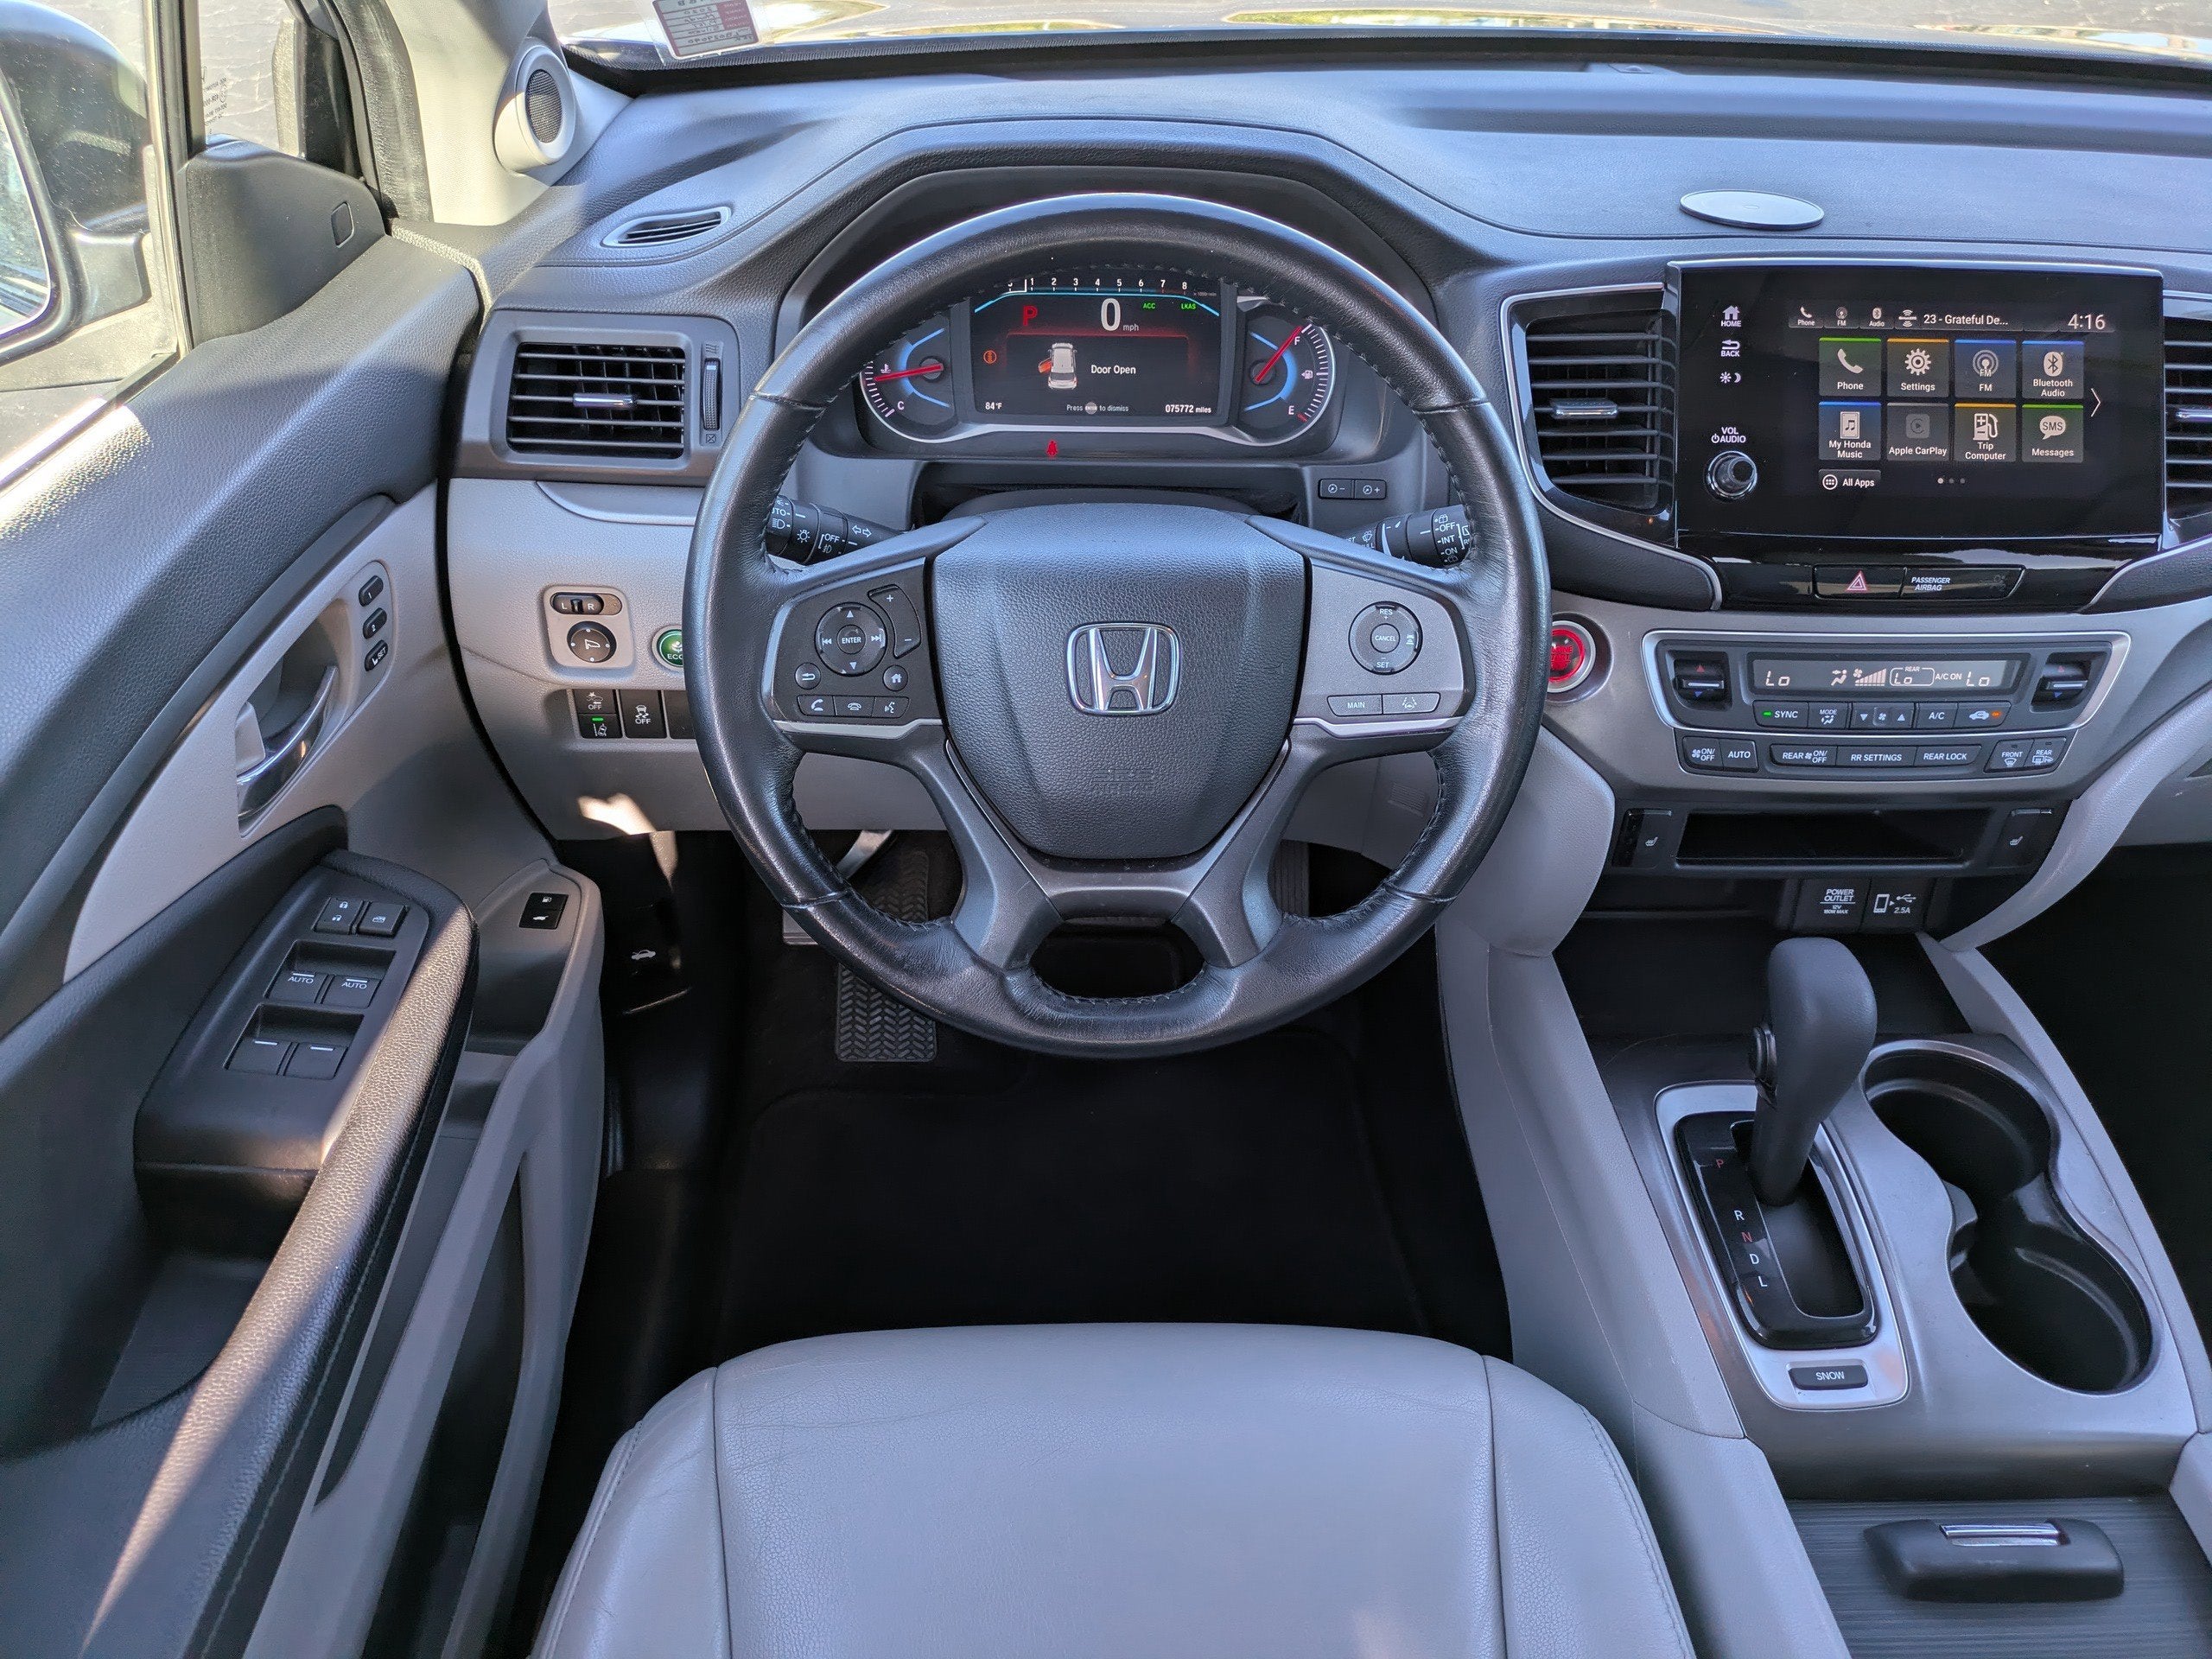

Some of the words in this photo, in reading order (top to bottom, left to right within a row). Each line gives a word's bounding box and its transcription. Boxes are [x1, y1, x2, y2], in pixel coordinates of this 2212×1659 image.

[1052, 277, 1057, 286] 2
[1073, 277, 1078, 286] 3
[1095, 277, 1101, 286] 4
[1116, 278, 1122, 287] 5
[1160, 279, 1166, 288] 7
[1022, 305, 1038, 326] P
[1100, 297, 1121, 331] 0
[1122, 323, 1140, 332] mph
[1923, 314, 1936, 324] 23
[1944, 314, 1985, 325] Grateful
[2067, 314, 2106, 330] 4:16
[1294, 336, 1300, 346] F
[1090, 365, 1111, 374] Door
[1113, 365, 1136, 375] Open
[1837, 381, 1864, 390] Phone
[1900, 383, 1936, 393] Settings
[1979, 384, 1993, 392] FM
[2032, 378, 2073, 388] Bluetooth
[2040, 389, 2065, 397] Audio
[897, 400, 905, 410] C
[1107, 404, 1129, 412] dismiss
[1165, 404, 1194, 413] 075772
[1288, 405, 1294, 415] E
[1720, 426, 1738, 435] VOL
[2042, 421, 2063, 431] SMS
[1719, 435, 1746, 443] AUDIO
[1828, 440, 1841, 449] My
[1843, 440, 1872, 448] Honda
[1977, 442, 1993, 451] Trip
[1837, 450, 1863, 459] Music
[1889, 446, 1913, 456] Apple
[1915, 446, 1948, 456] CarPlay
[2031, 448, 2074, 458] Messages
[1965, 452, 2006, 461] Computer
[1842, 478, 1853, 486] All
[1854, 478, 1875, 488] Apps
[772, 507, 786, 516] UTO
[1439, 521, 1455, 532] OFF
[824, 533, 840, 543] OFF
[1440, 535, 1455, 545] INT
[1443, 547, 1459, 556] ON
[842, 636, 861, 645] ENTER
[1347, 701, 1366, 709] MAIN
[1774, 710, 1798, 719] SYNC
[1929, 711, 1945, 720] A/C
[288, 976, 314, 984] AUTO
[342, 981, 367, 989] AUTO
[1715, 1158, 1725, 1168] P
[1733, 1210, 1745, 1221] R
[1741, 1231, 1752, 1243] N
[1749, 1254, 1759, 1265] D
[1758, 1275, 1768, 1287] L
[1815, 1370, 1845, 1381] SNOW
